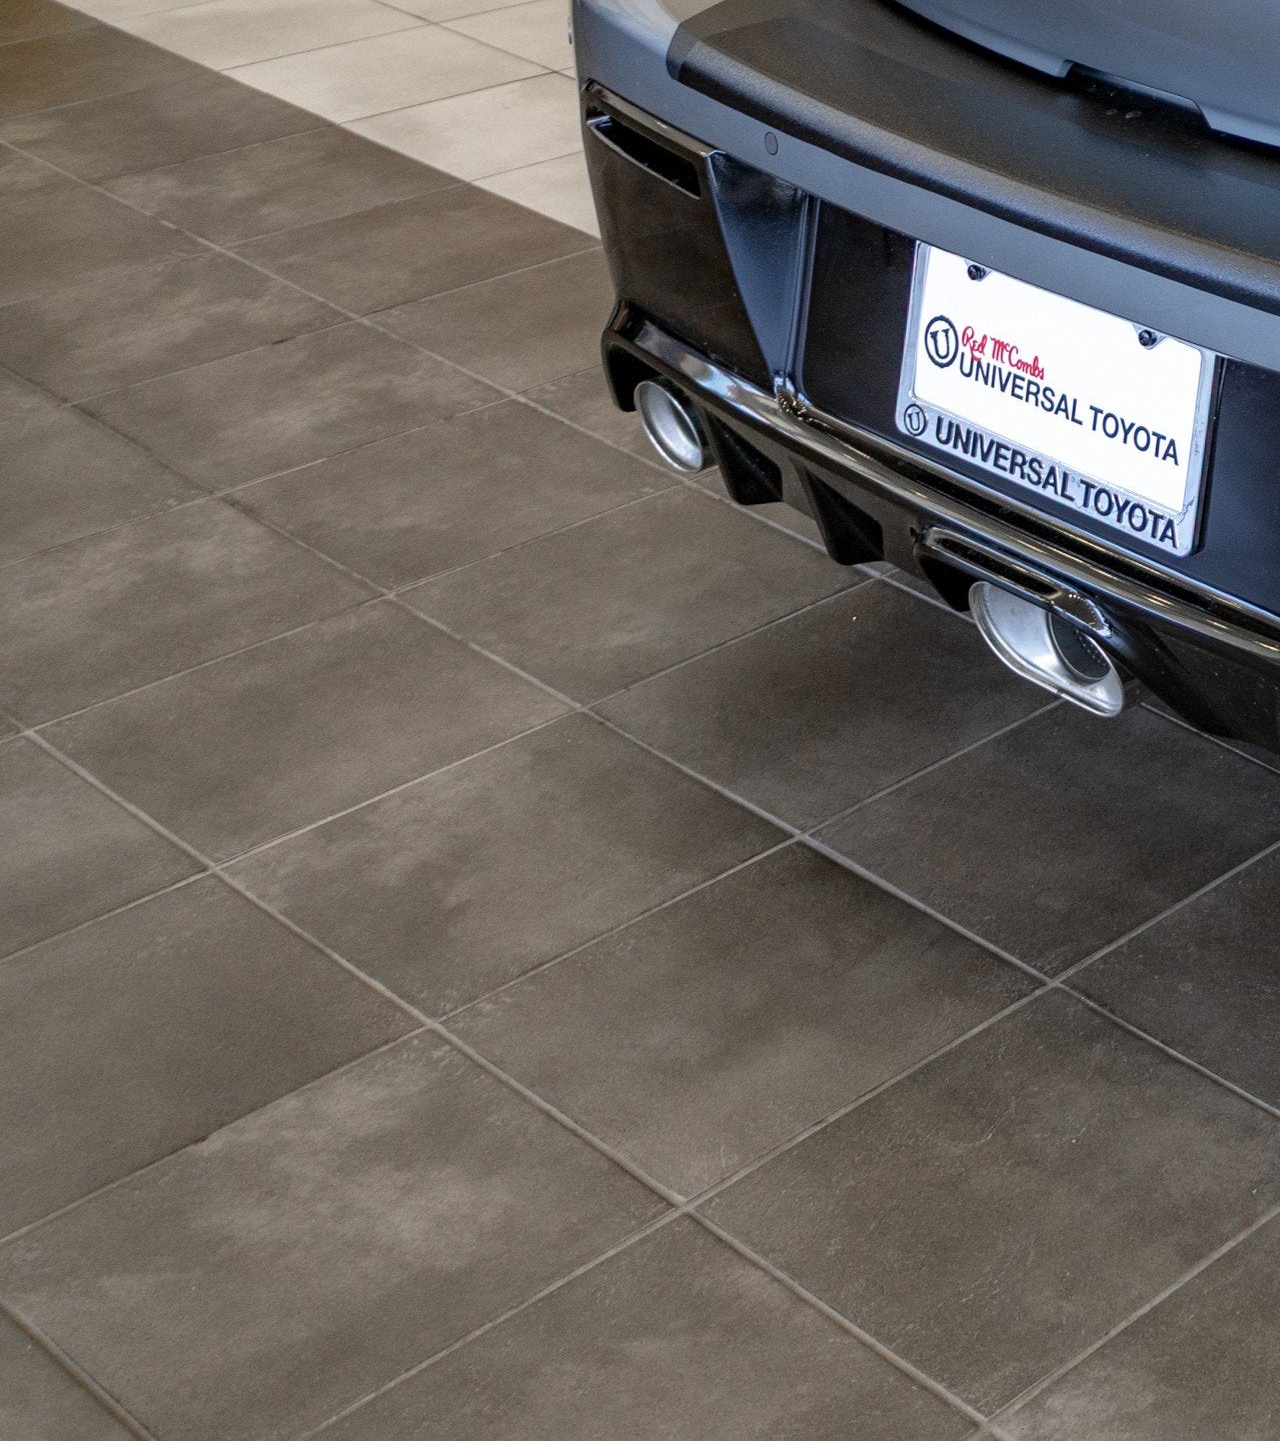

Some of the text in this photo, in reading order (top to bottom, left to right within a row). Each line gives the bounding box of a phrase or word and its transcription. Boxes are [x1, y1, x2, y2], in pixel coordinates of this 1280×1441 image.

[962, 325, 988, 362] Red
[960, 351, 1179, 467] UNIVERSAL TOYOTA
[935, 415, 1179, 549] UNIVERSAL TOYOTA
